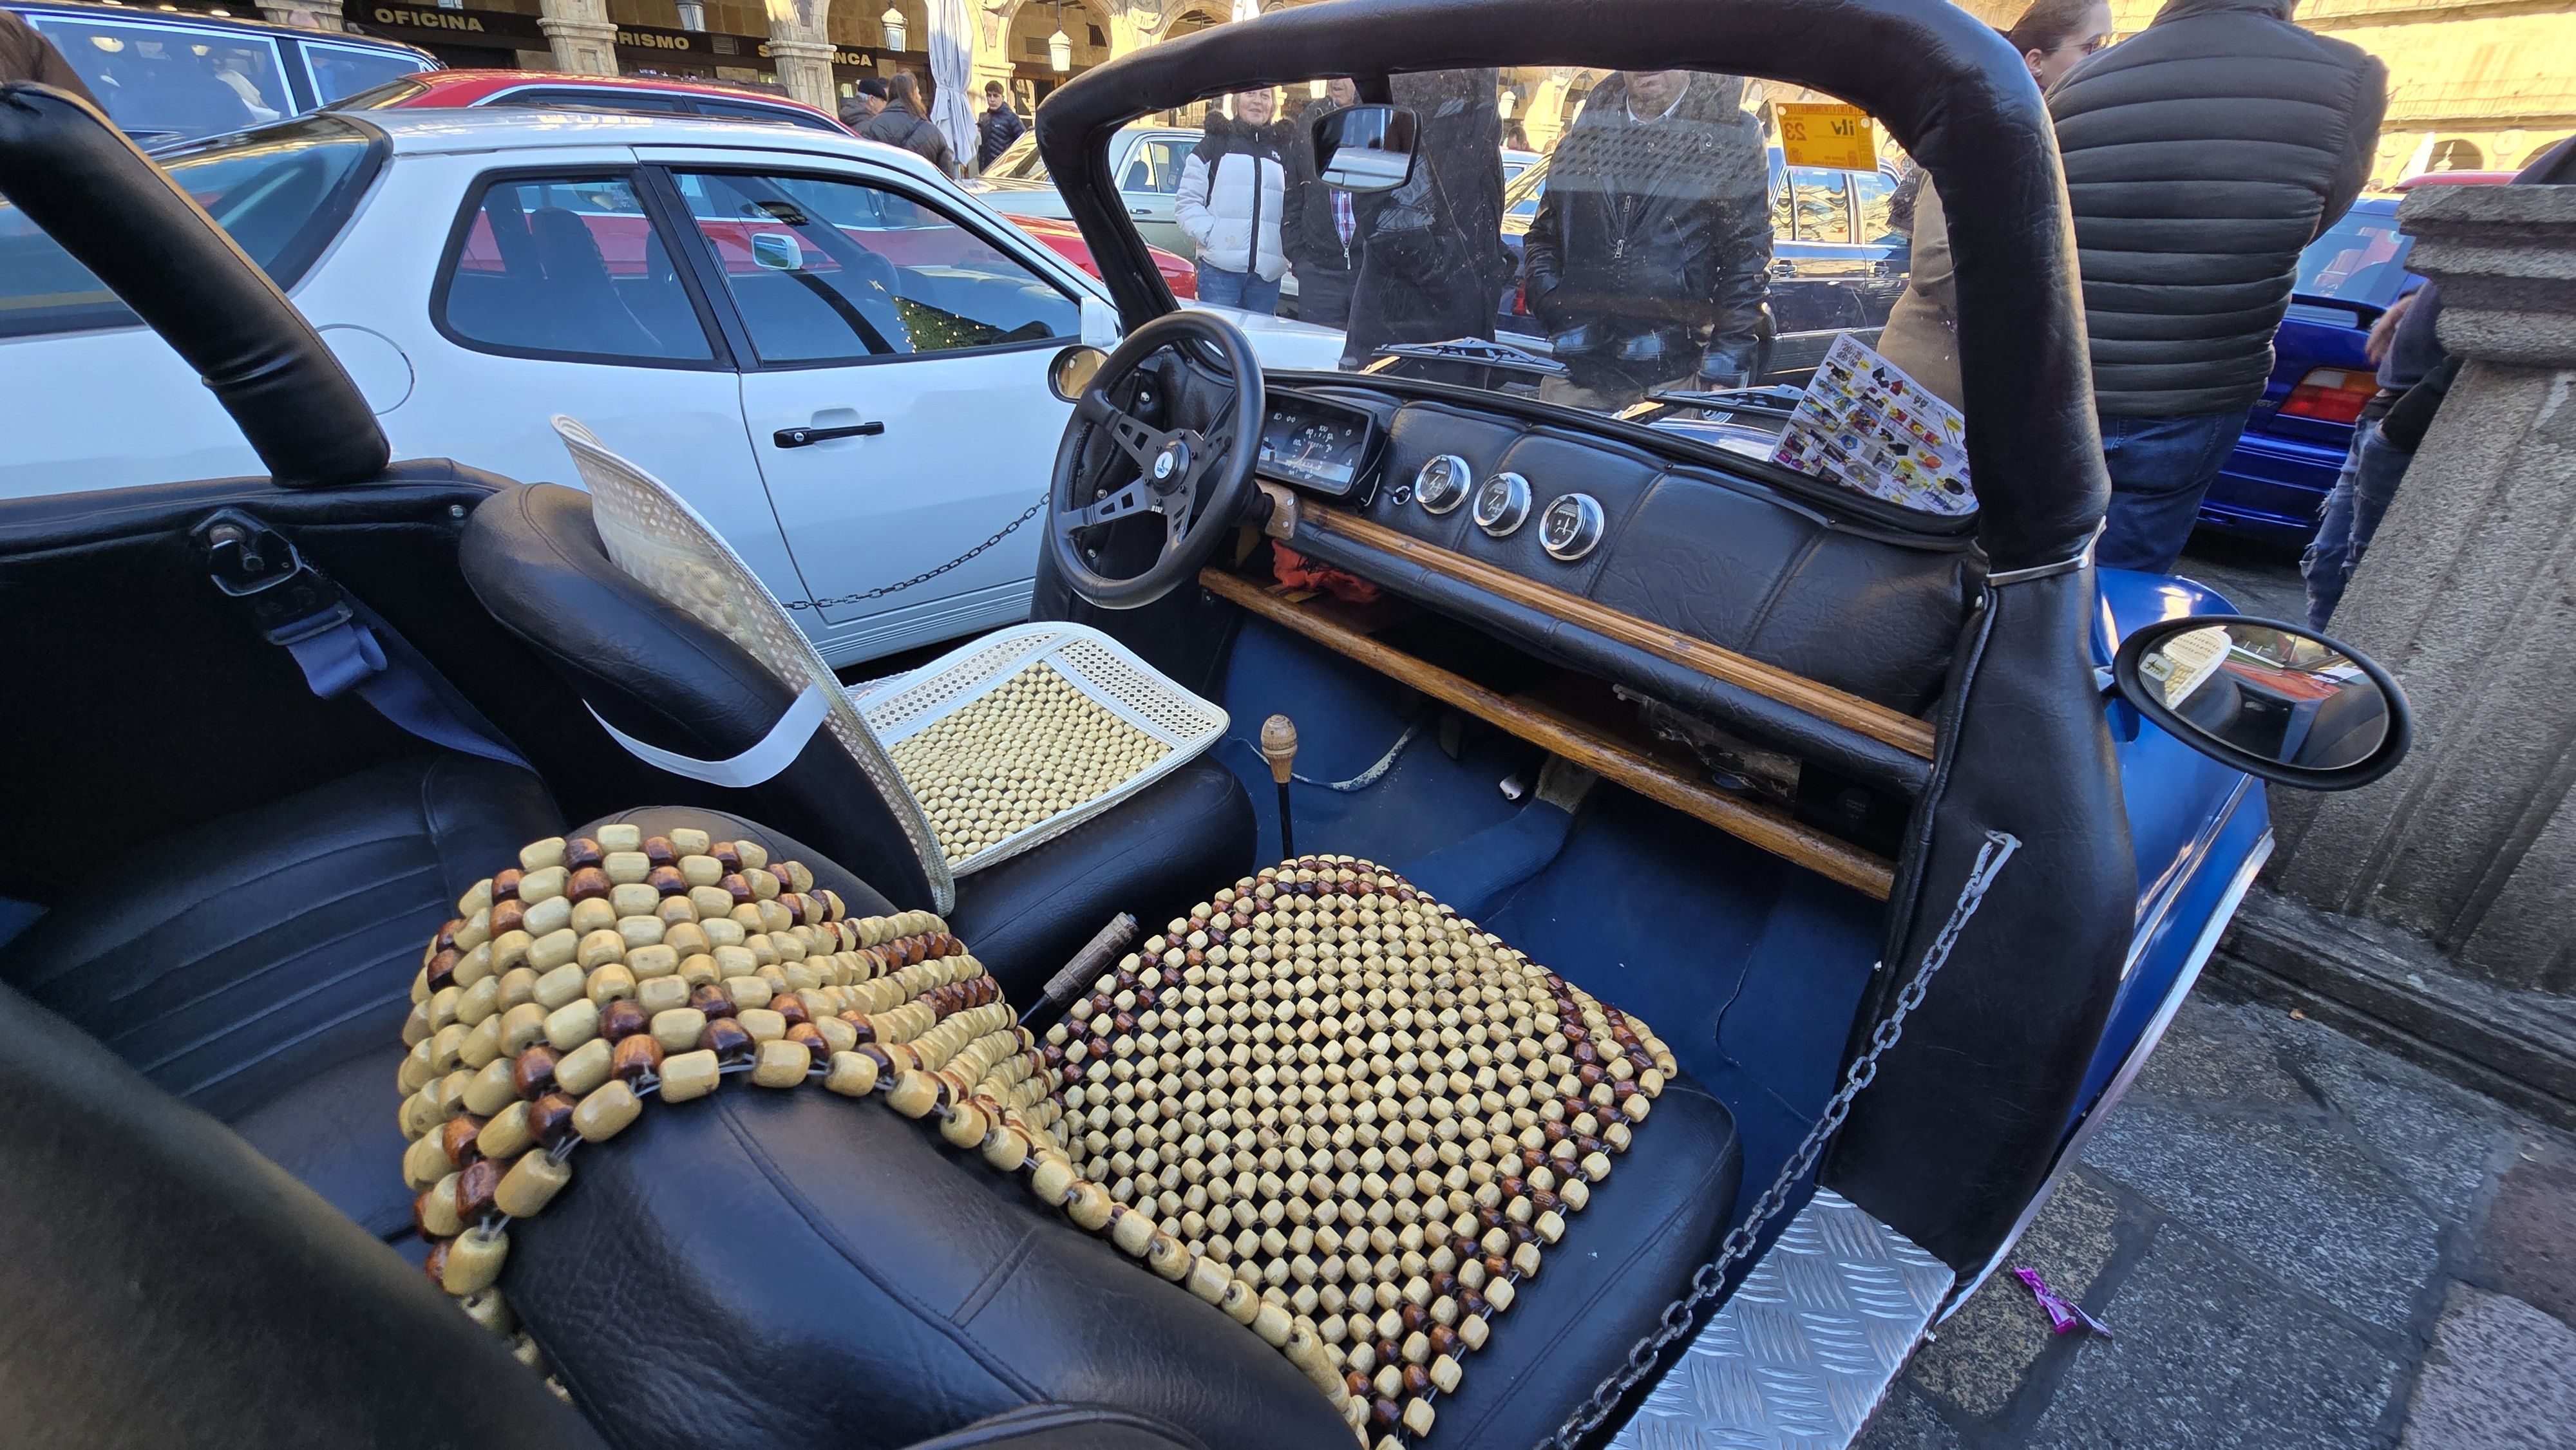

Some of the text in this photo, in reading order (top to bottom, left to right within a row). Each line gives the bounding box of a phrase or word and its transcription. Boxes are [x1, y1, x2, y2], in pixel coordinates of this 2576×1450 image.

[375, 8, 484, 32] OFICINA
[618, 32, 689, 50] RISMO
[758, 44, 771, 57] S
[833, 52, 872, 66] NCA
